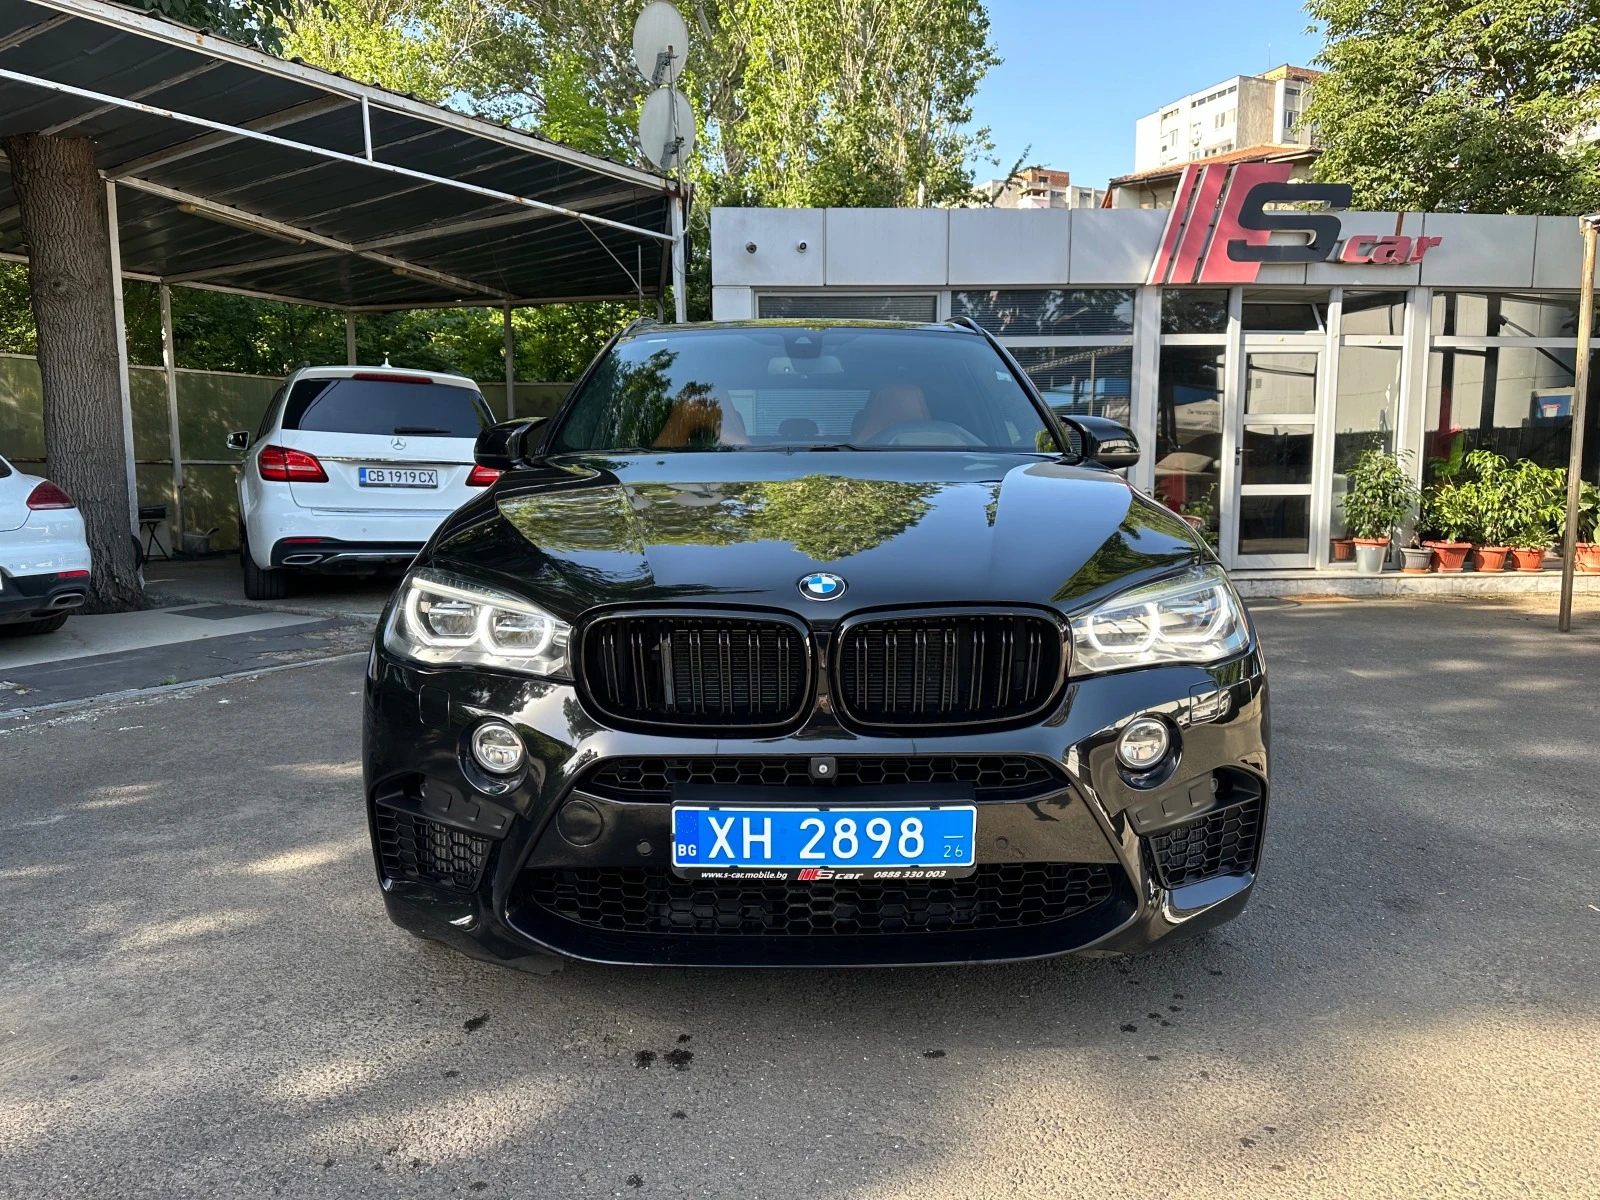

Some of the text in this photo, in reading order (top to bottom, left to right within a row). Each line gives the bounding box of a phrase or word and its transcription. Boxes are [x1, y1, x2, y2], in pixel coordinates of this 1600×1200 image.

[368, 470, 385, 482] CB
[388, 471, 416, 483] 1919
[418, 472, 435, 483] CX
[707, 816, 925, 860] XH 2898
[678, 844, 697, 857] BG
[943, 845, 964, 858] 26
[701, 870, 788, 880] www.s-car.mobile.bg
[873, 871, 901, 879] 0888
[925, 870, 947, 878] 003
